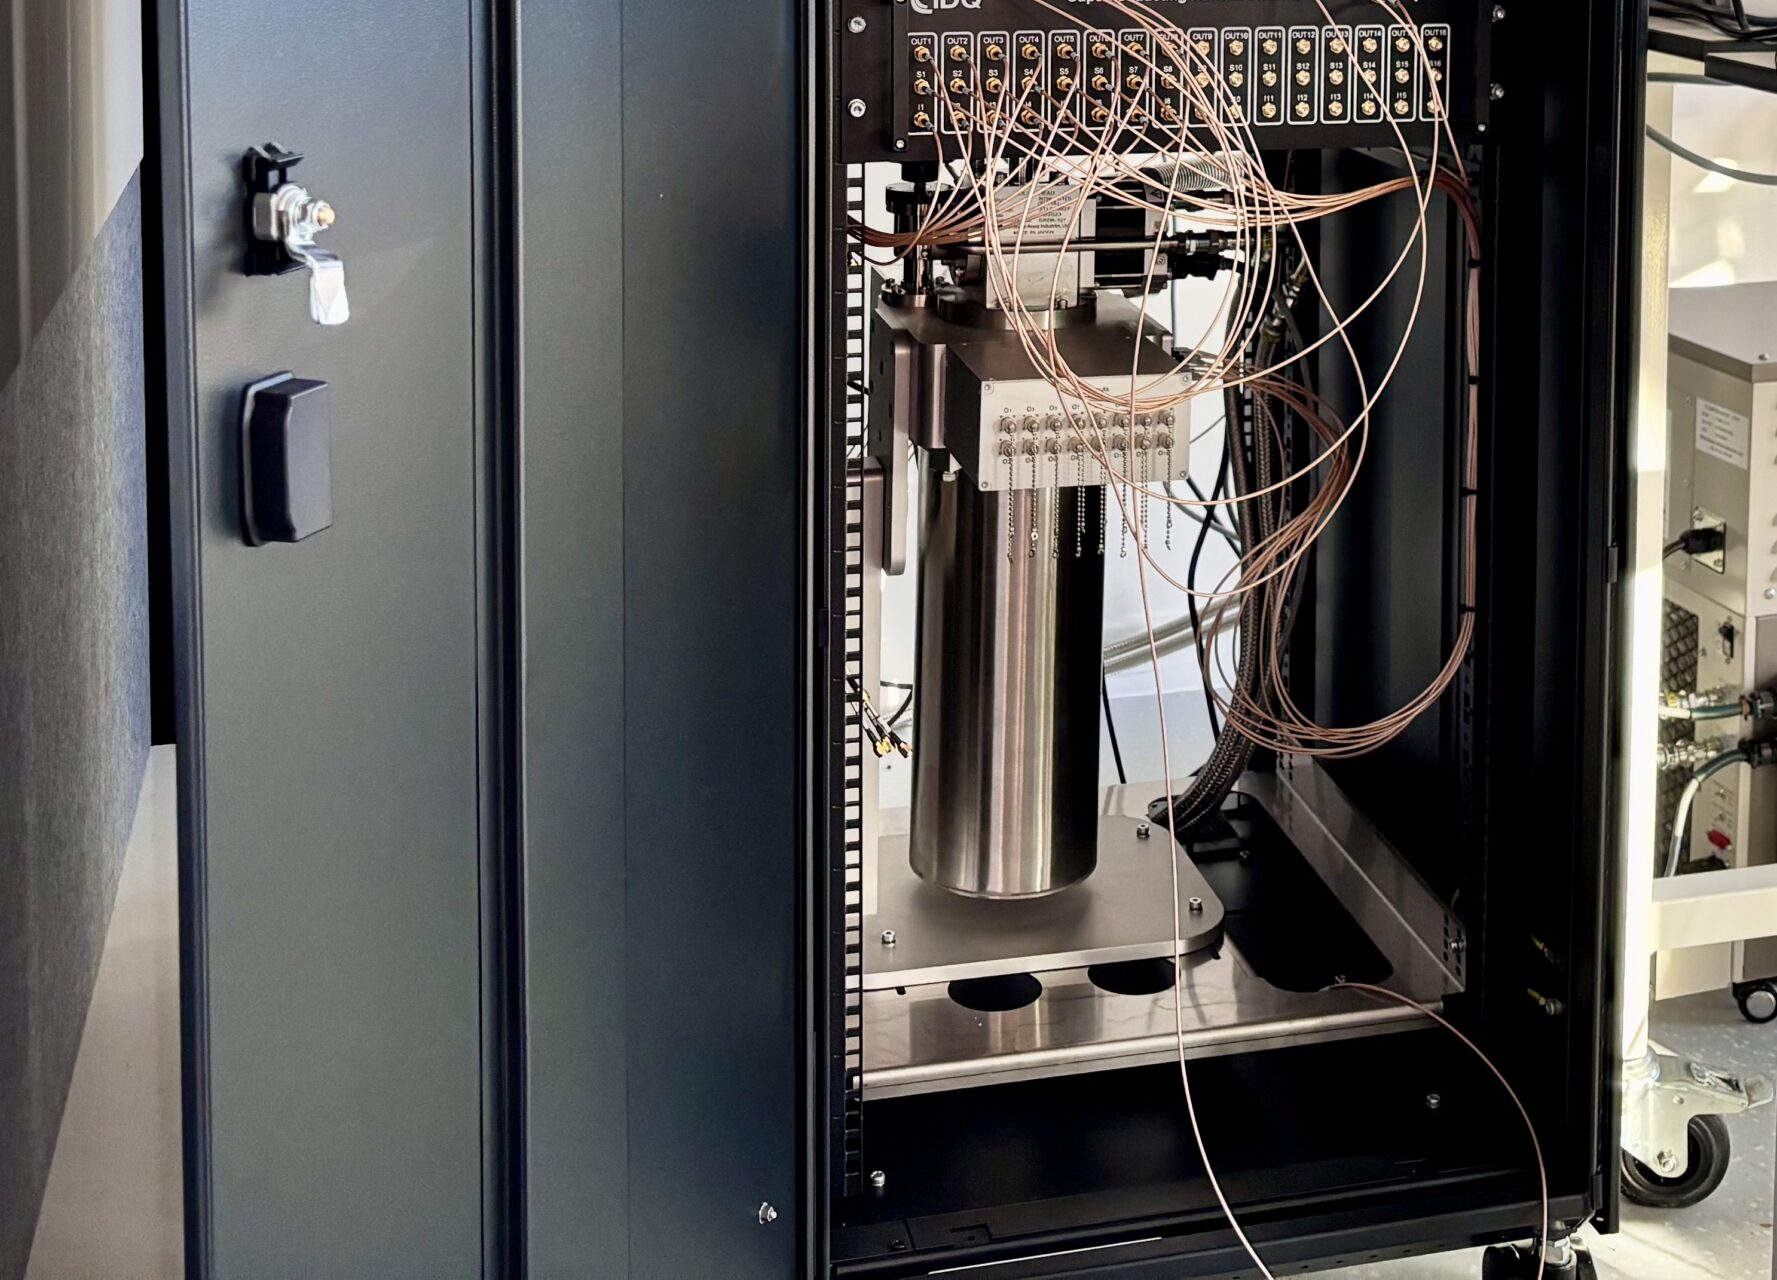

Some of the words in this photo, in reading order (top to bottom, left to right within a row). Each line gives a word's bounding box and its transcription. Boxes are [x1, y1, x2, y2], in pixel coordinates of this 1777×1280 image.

[1124, 33, 1144, 41] OUT7
[1192, 32, 1213, 40] OUT9
[1224, 32, 1249, 40] OUT10
[1258, 31, 1281, 40] OUT11
[1292, 31, 1316, 39] OUT12
[1358, 30, 1382, 38] OUT14
[1424, 29, 1447, 37] OUT16
[911, 37, 931, 46] OUT1
[947, 37, 968, 45] OUT2
[983, 36, 1004, 44] OUT3
[1019, 35, 1040, 43] OUT4
[1054, 35, 1074, 43] OUT5
[1229, 64, 1243, 72] S10
[1263, 63, 1277, 71] S11
[1362, 61, 1376, 69] S14
[1395, 60, 1409, 69] S15
[916, 70, 926, 78] S1
[952, 69, 963, 78] S2
[988, 69, 999, 77] S3
[1023, 68, 1034, 76] S4
[1059, 68, 1070, 76] S5
[1094, 67, 1104, 75] S6
[1128, 66, 1139, 74] S7
[1263, 95, 1274, 103] I11
[1297, 94, 1308, 102] I12
[1330, 93, 1342, 101] I13
[917, 103, 925, 111] I1
